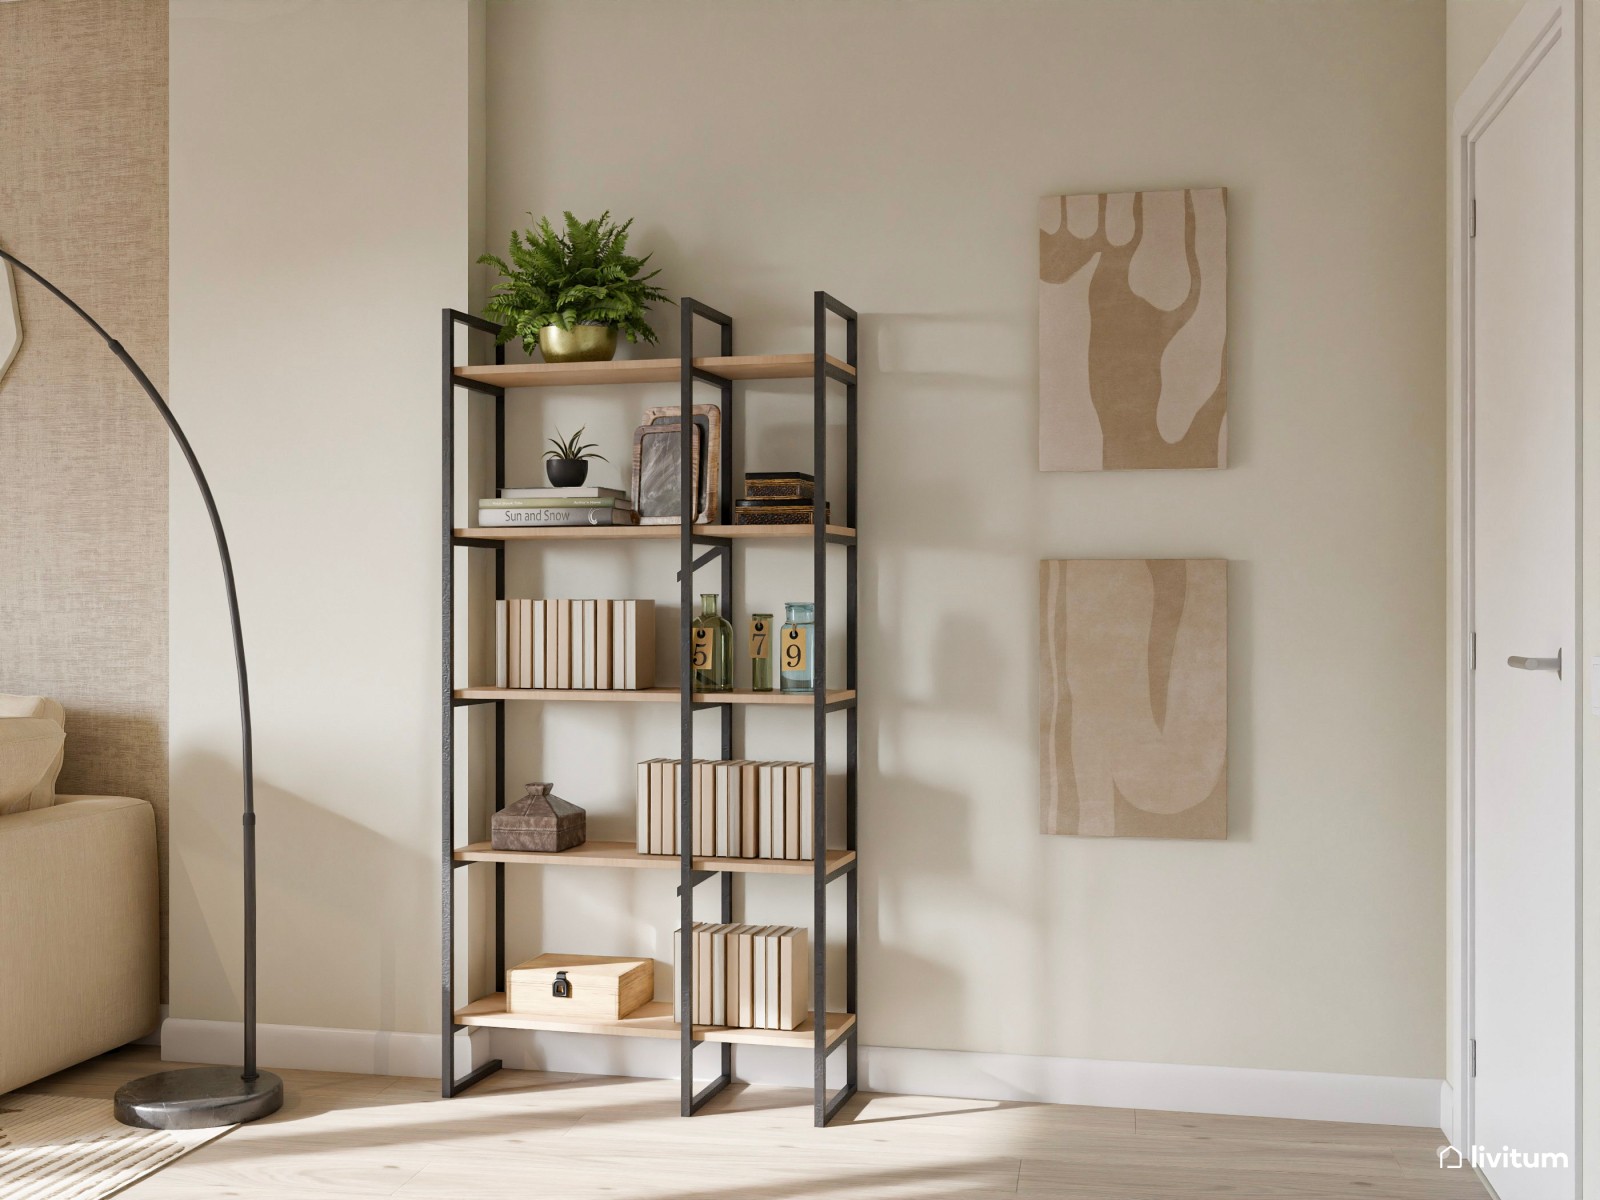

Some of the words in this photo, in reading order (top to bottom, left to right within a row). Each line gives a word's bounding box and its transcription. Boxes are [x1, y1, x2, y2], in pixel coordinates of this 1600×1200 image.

[505, 510, 522, 521] Sun
[524, 510, 542, 521] and
[544, 510, 570, 521] Snow
[693, 643, 707, 666] 5
[752, 633, 766, 655] 7
[786, 644, 801, 667] 9
